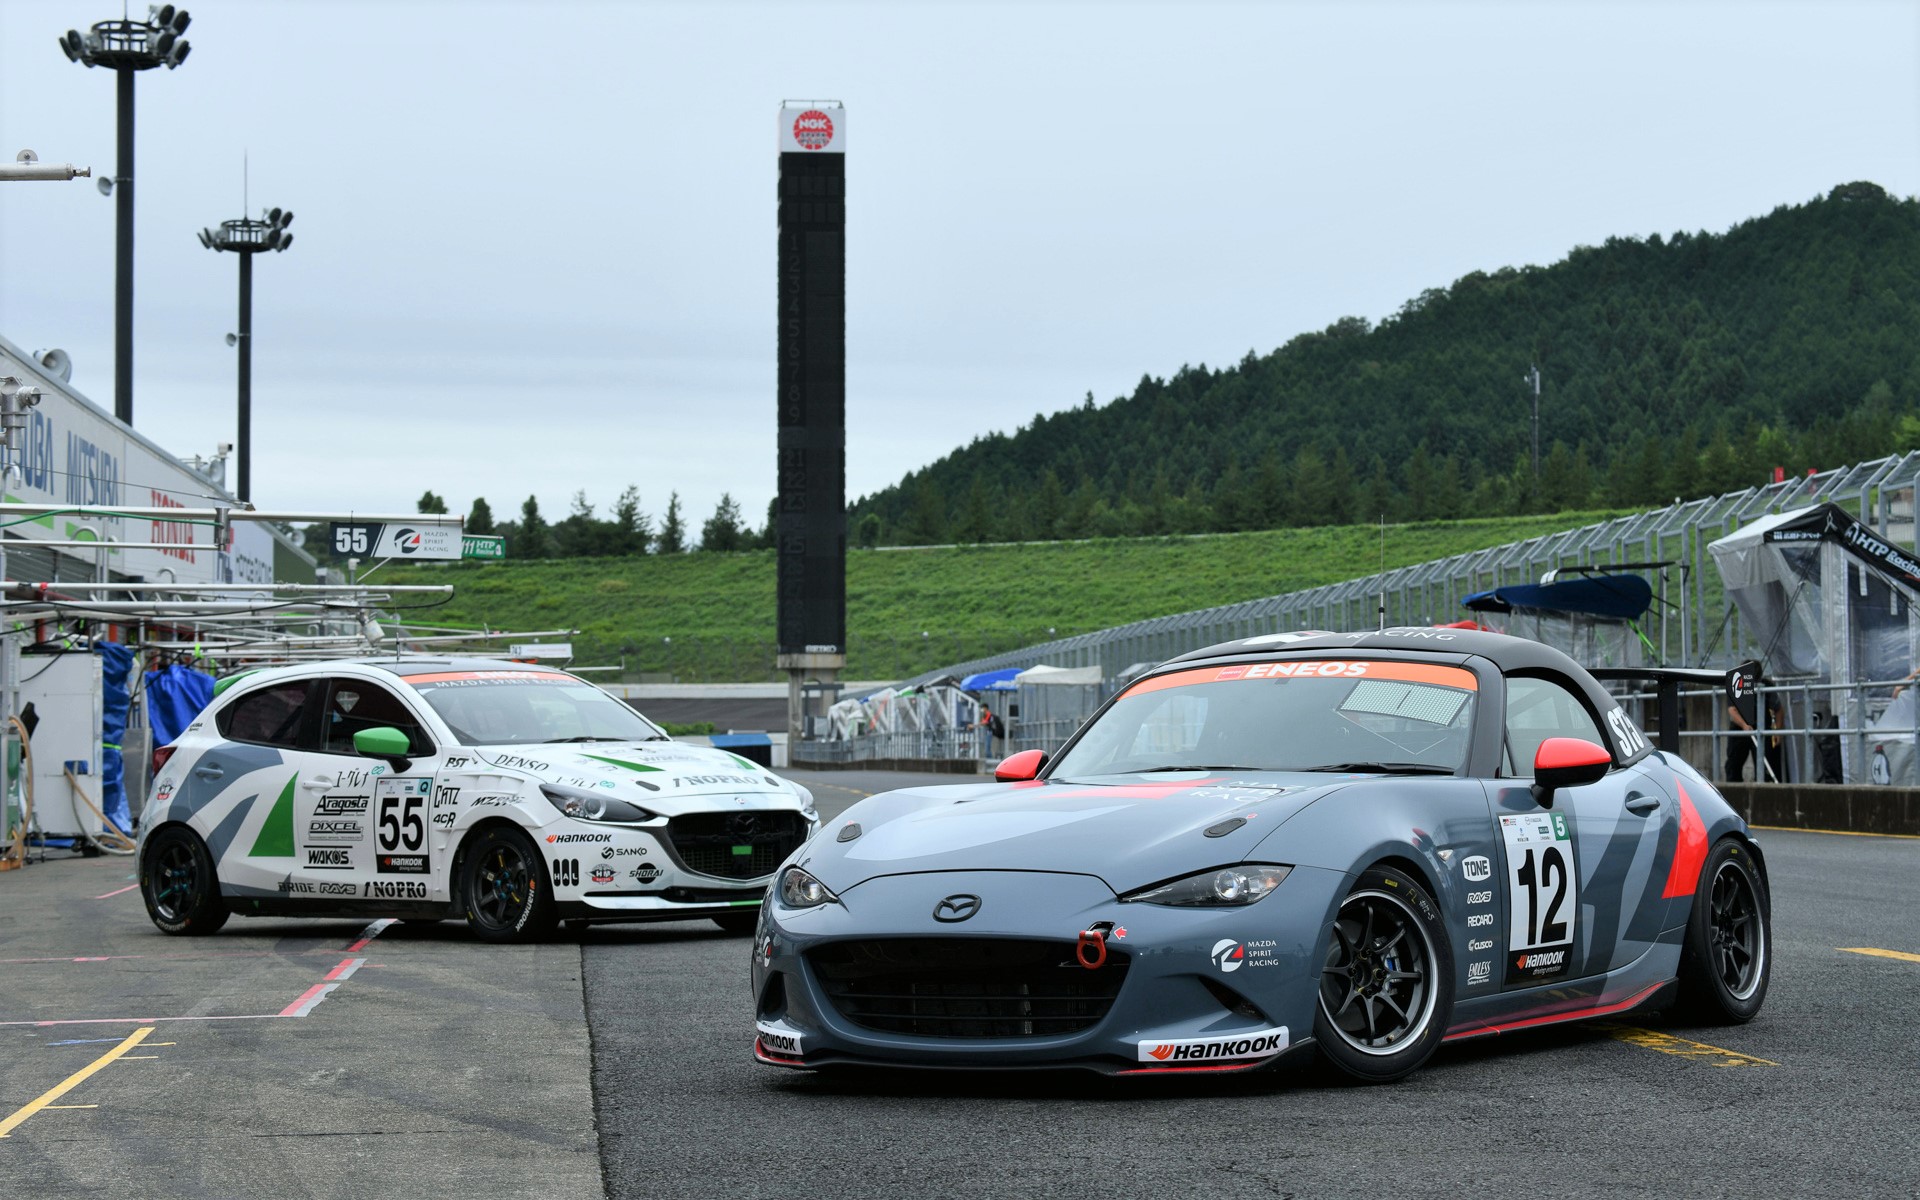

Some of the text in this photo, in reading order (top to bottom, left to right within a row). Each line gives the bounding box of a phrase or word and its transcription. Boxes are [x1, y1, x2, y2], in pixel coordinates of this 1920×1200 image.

[799, 119, 828, 129] NGK
[151, 490, 195, 564] HONDA
[335, 527, 368, 553] 55
[1857, 533, 1889, 556] HTP
[1246, 661, 1371, 679] ENEOS
[435, 680, 488, 689] MAZDA
[494, 754, 550, 771] DENSO
[420, 781, 429, 793] Q
[434, 785, 461, 808] CATZ
[313, 795, 369, 816] Aragosta
[310, 822, 361, 834] DIXCEL
[379, 797, 424, 851] 55
[1555, 815, 1566, 837] 5
[629, 869, 664, 878] SHORAI
[1464, 859, 1488, 877] TONE
[278, 881, 316, 893] BRIDE
[320, 882, 357, 895] RAYS
[1467, 890, 1492, 904] RAYS
[1517, 846, 1568, 946] 12
[1467, 913, 1494, 927] RECARO
[1248, 959, 1279, 967] RACING
[1468, 960, 1491, 977] ENDLESS
